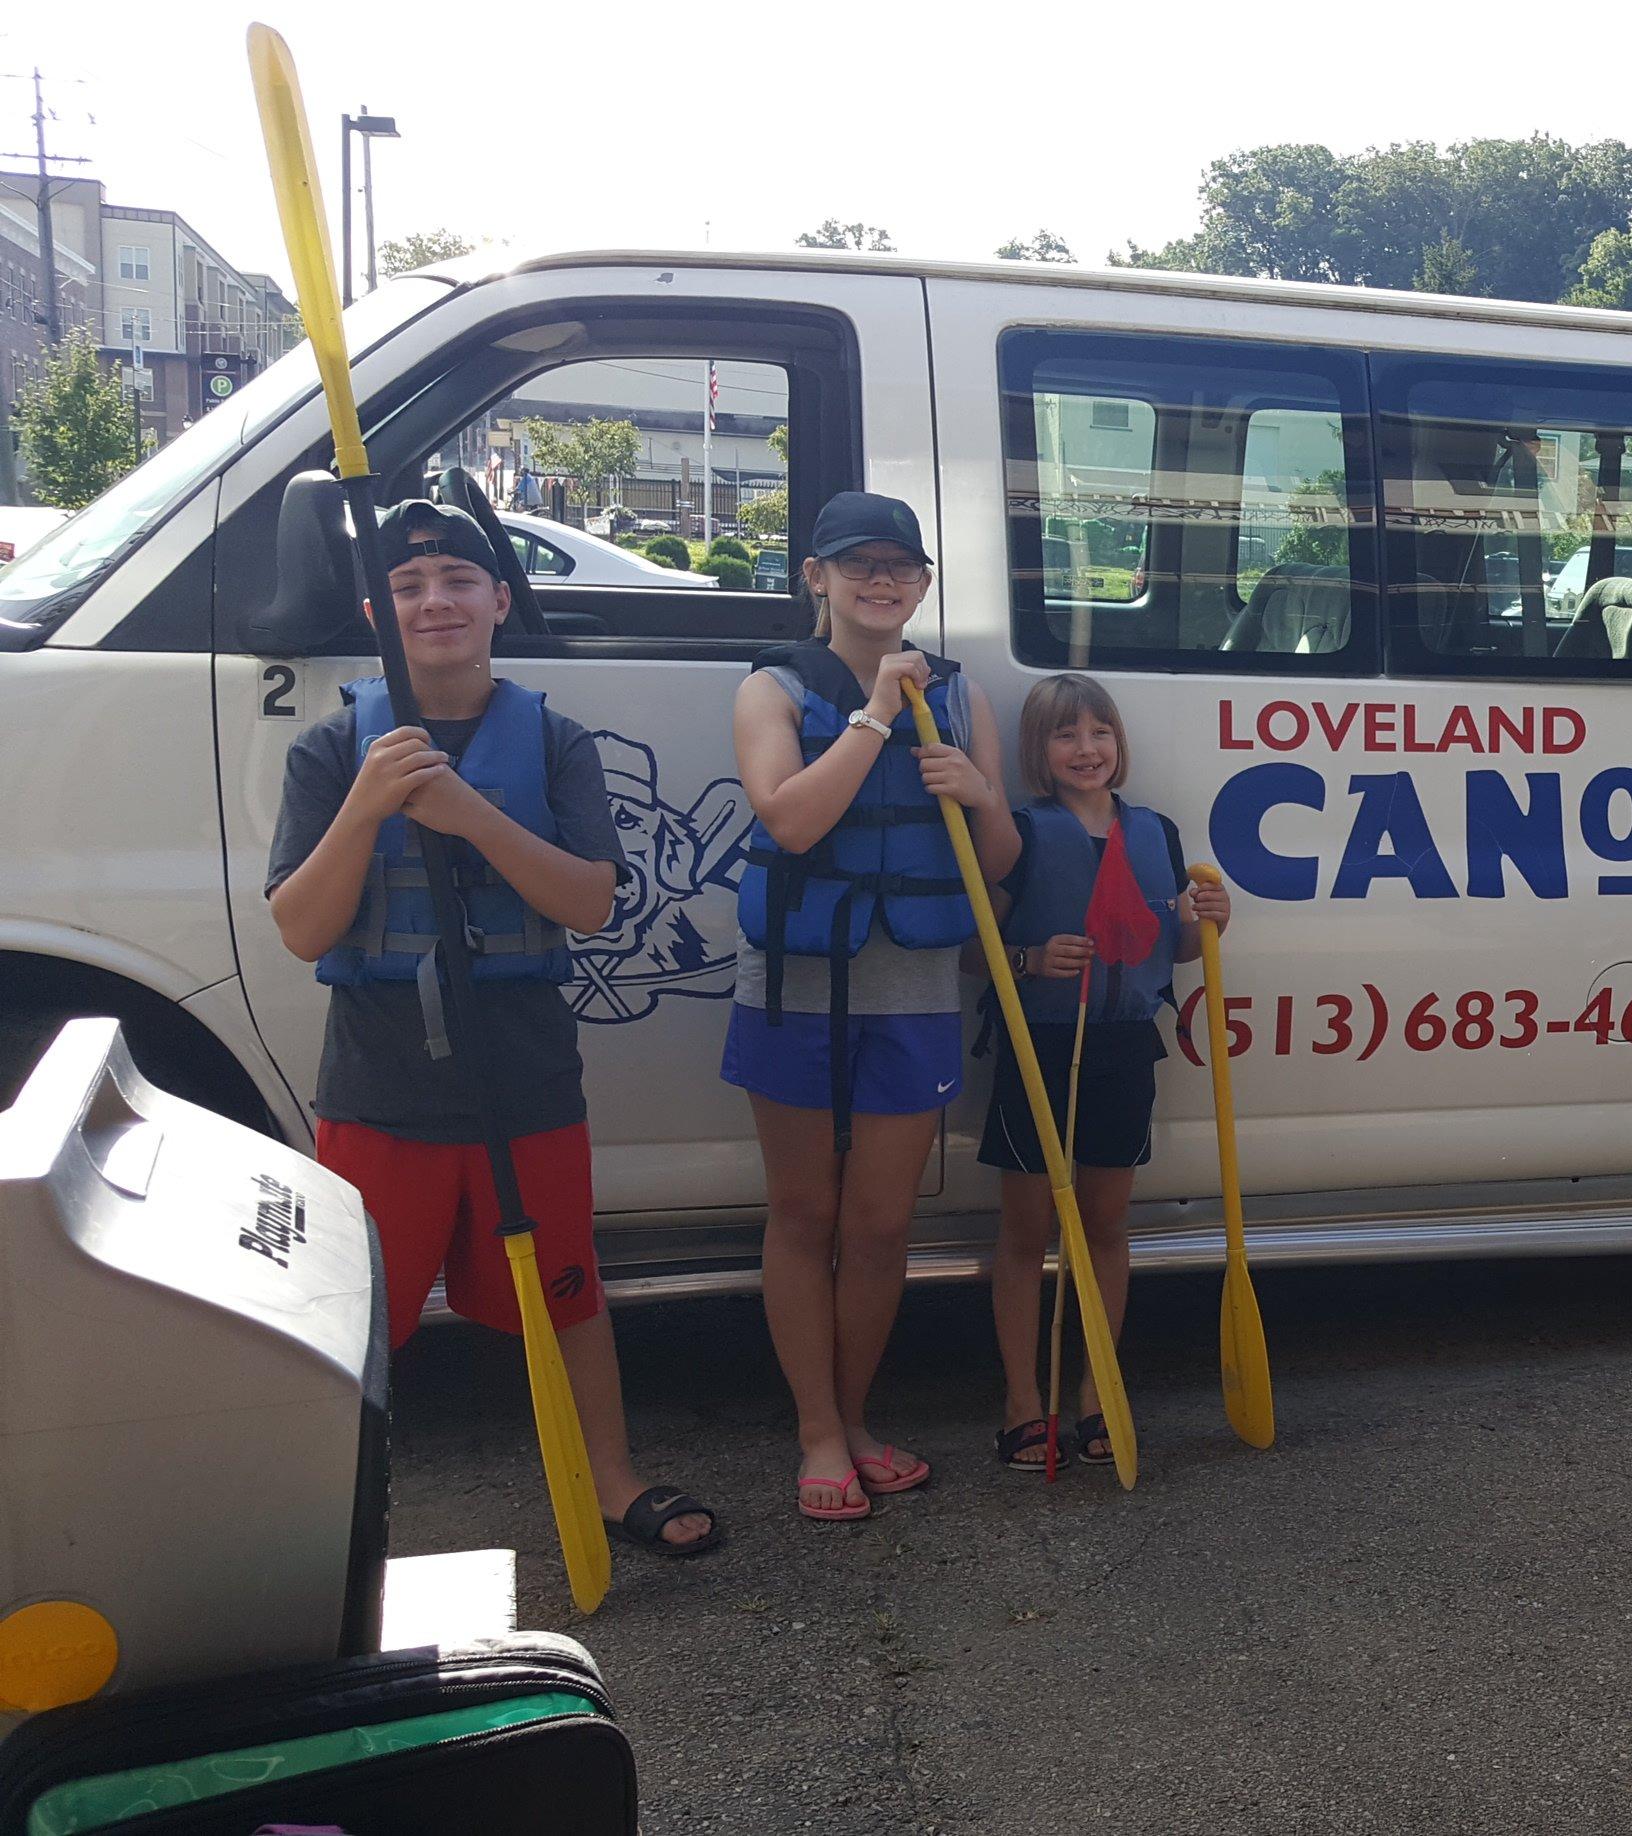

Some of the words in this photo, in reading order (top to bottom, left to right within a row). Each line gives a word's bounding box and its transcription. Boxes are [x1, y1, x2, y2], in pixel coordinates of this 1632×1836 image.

[263, 664, 296, 717] 2
[1218, 699, 1587, 755] LOVELAND
[1175, 983, 1389, 1067] (513)
